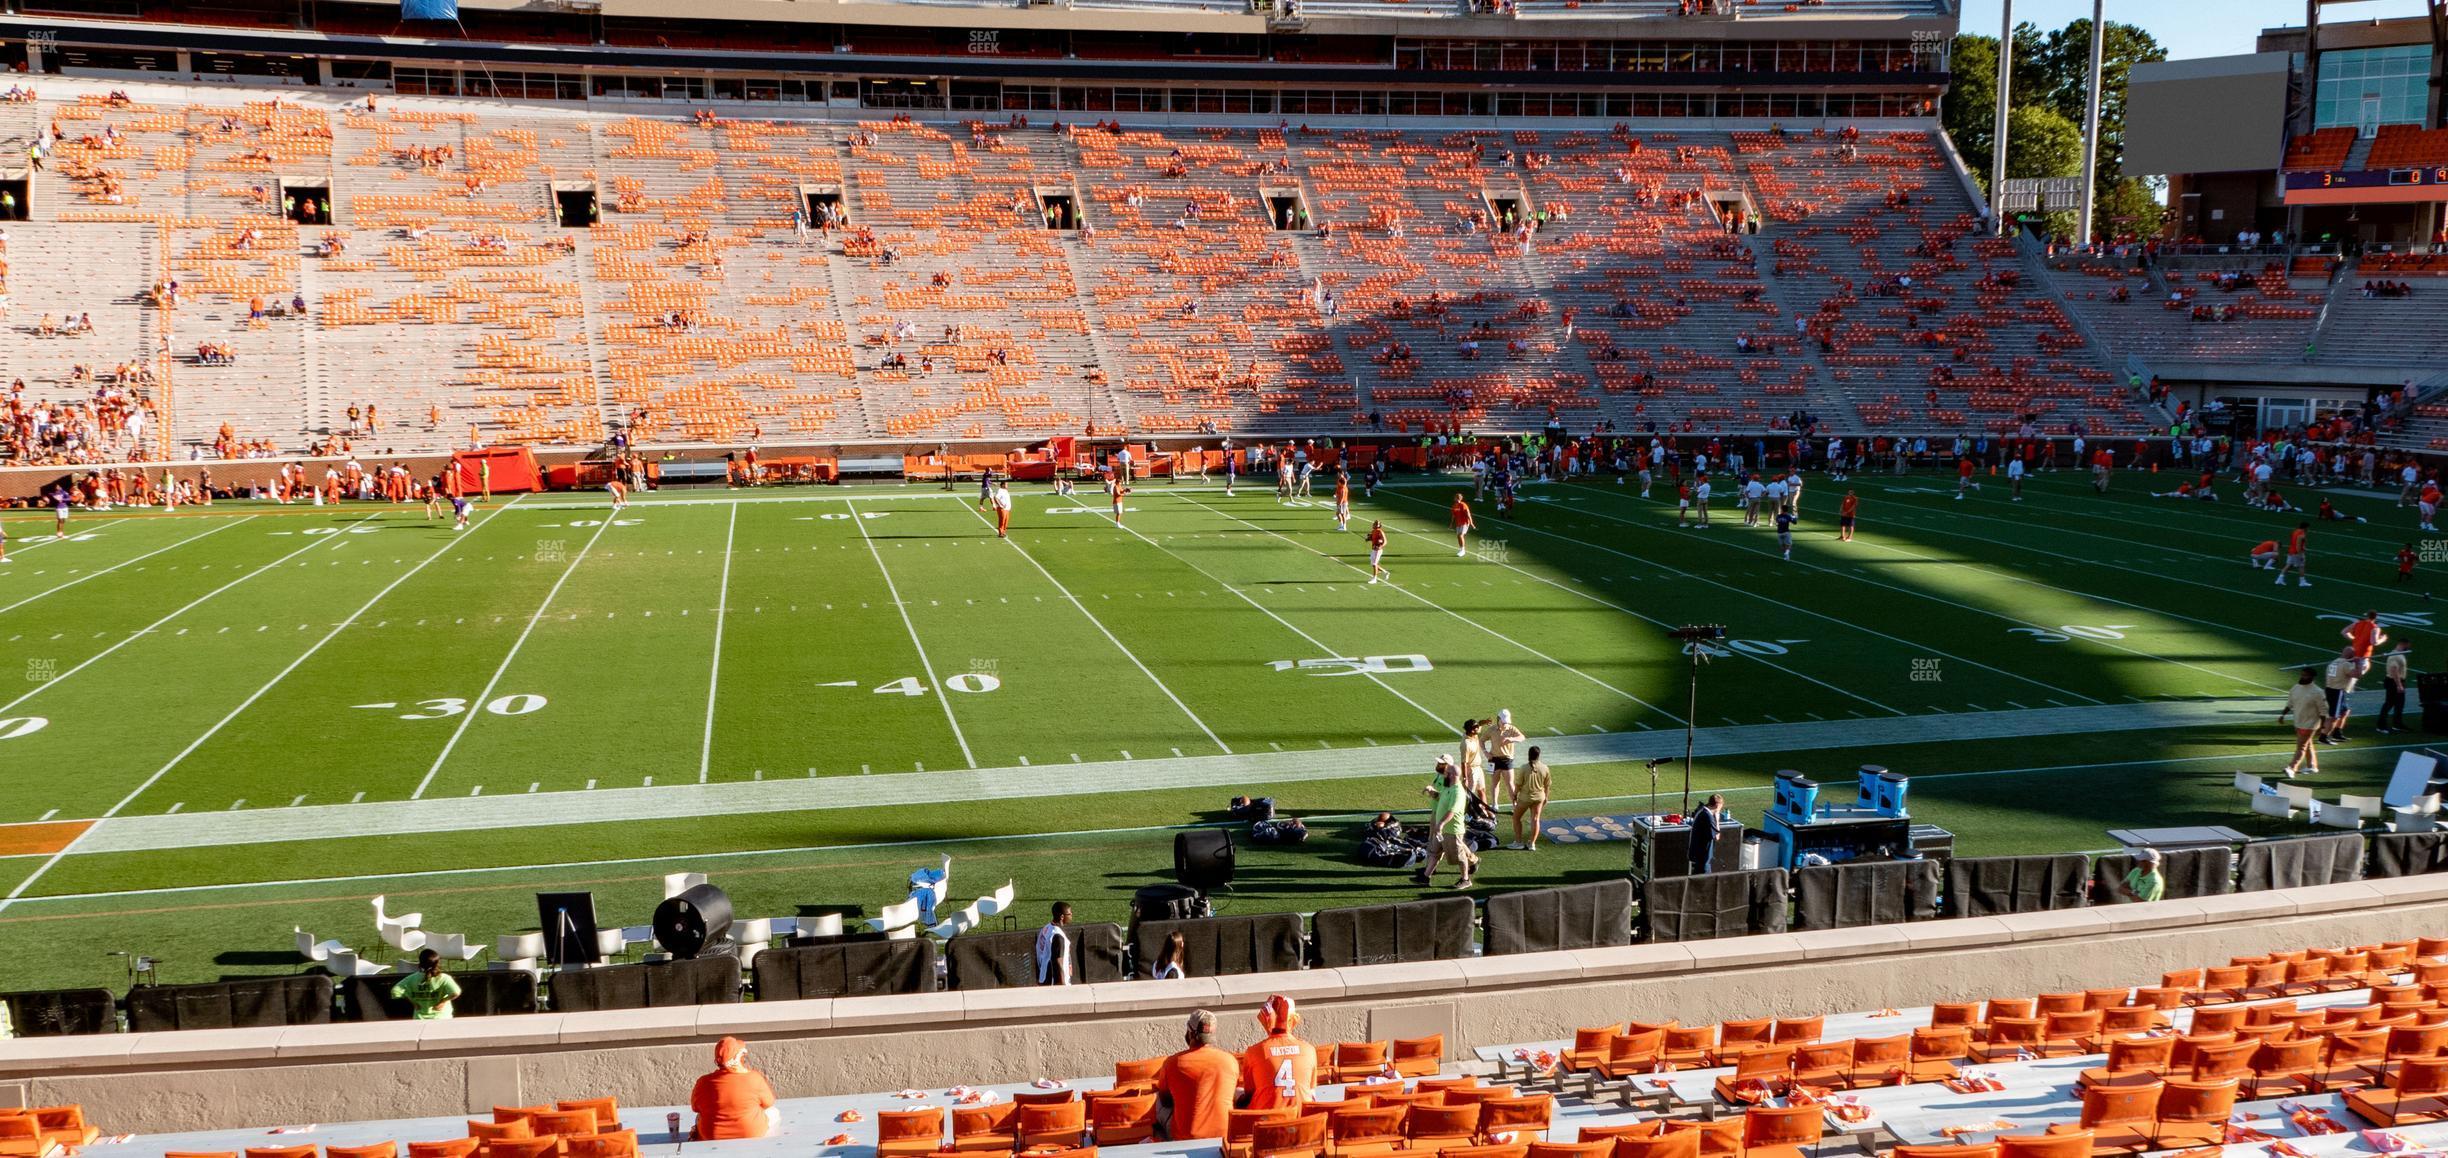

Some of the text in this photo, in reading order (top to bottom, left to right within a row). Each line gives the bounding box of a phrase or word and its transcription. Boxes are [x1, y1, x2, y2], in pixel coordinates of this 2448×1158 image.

[873, 673, 1001, 696] 40
[400, 694, 548, 720] 30
[1269, 1045, 1301, 1057] WATSON
[1274, 1058, 1296, 1097] 4
